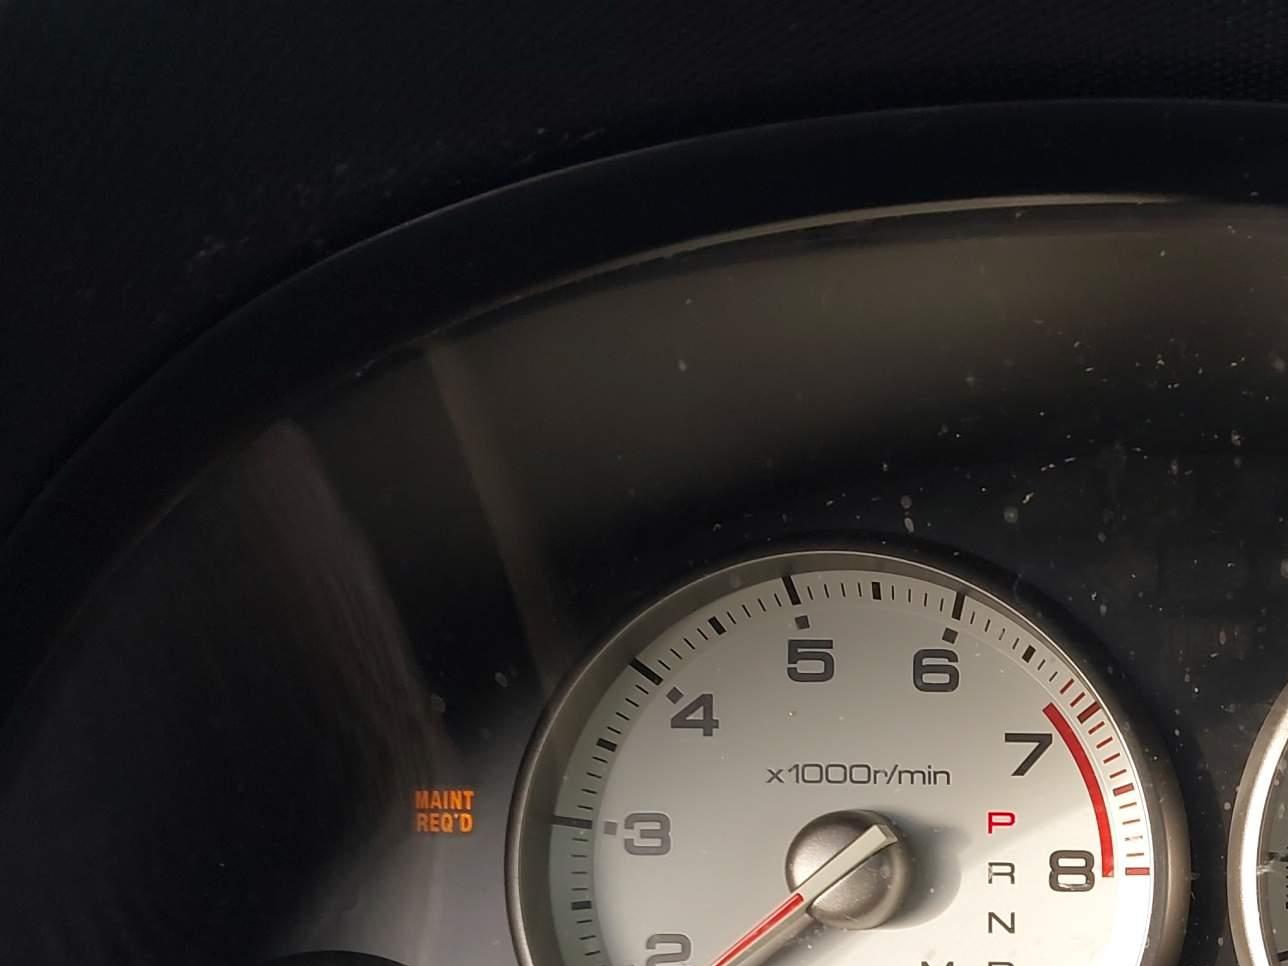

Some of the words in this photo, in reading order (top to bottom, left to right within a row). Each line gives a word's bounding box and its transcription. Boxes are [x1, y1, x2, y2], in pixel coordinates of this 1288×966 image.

[787, 640, 835, 683] 5
[913, 649, 960, 693] 6
[670, 693, 720, 737] 4
[1004, 733, 1053, 777] 7
[766, 763, 952, 787] x1000r/min
[415, 790, 475, 811] MAINT
[416, 812, 474, 833] REQ'D
[624, 812, 671, 856] 3
[987, 812, 1016, 834] P
[988, 862, 1016, 885] R
[1048, 850, 1096, 893] 8
[988, 912, 1016, 935] N
